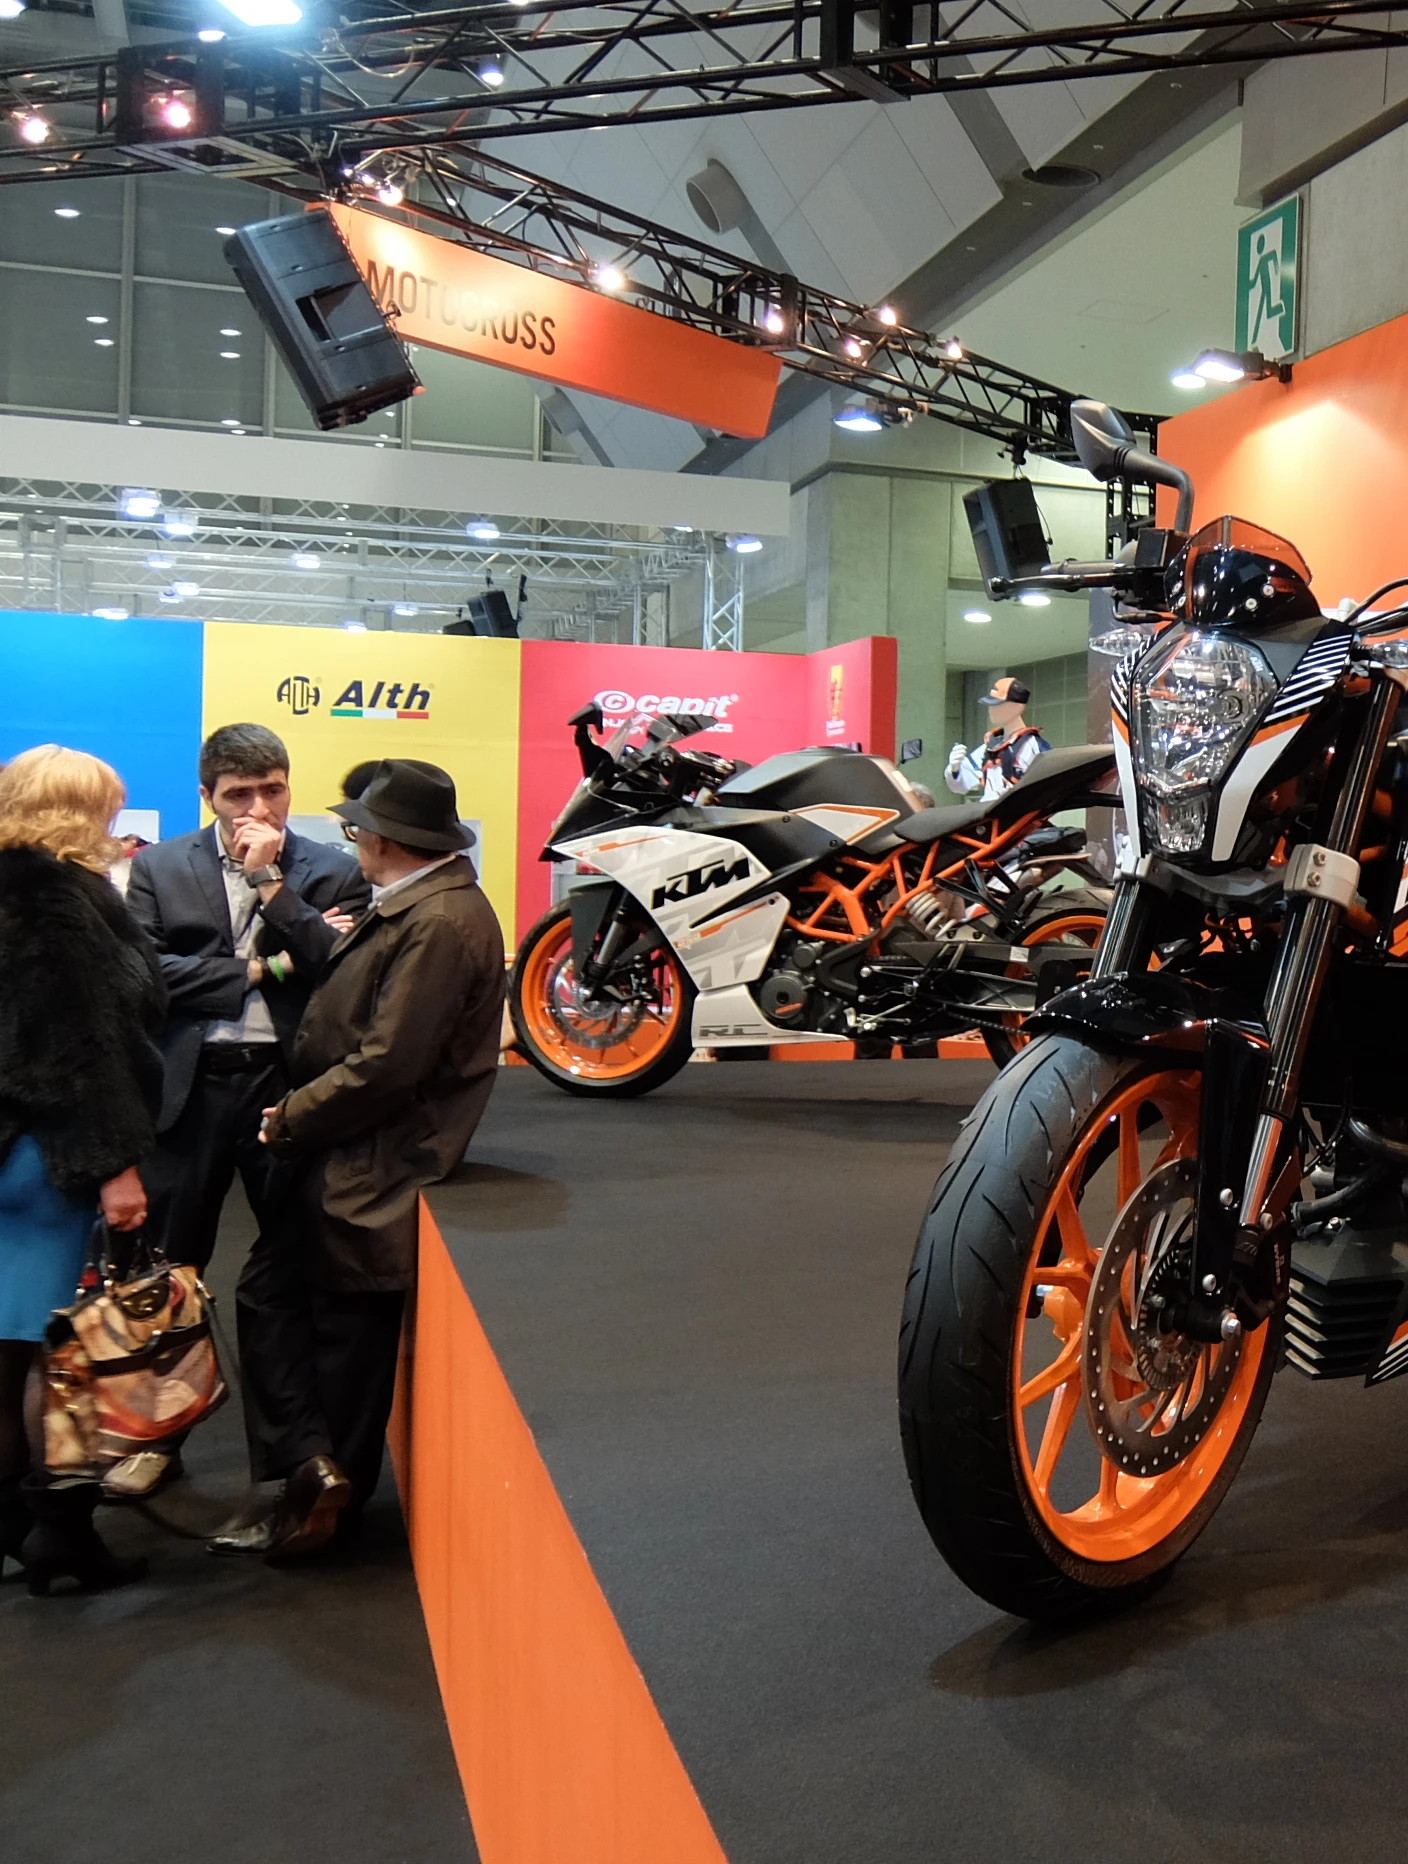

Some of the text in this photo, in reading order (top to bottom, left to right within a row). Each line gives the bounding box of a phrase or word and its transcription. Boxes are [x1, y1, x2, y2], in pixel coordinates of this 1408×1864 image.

[332, 680, 430, 710] Alth
[650, 857, 751, 910] KTM
[699, 1024, 768, 1037] RC
